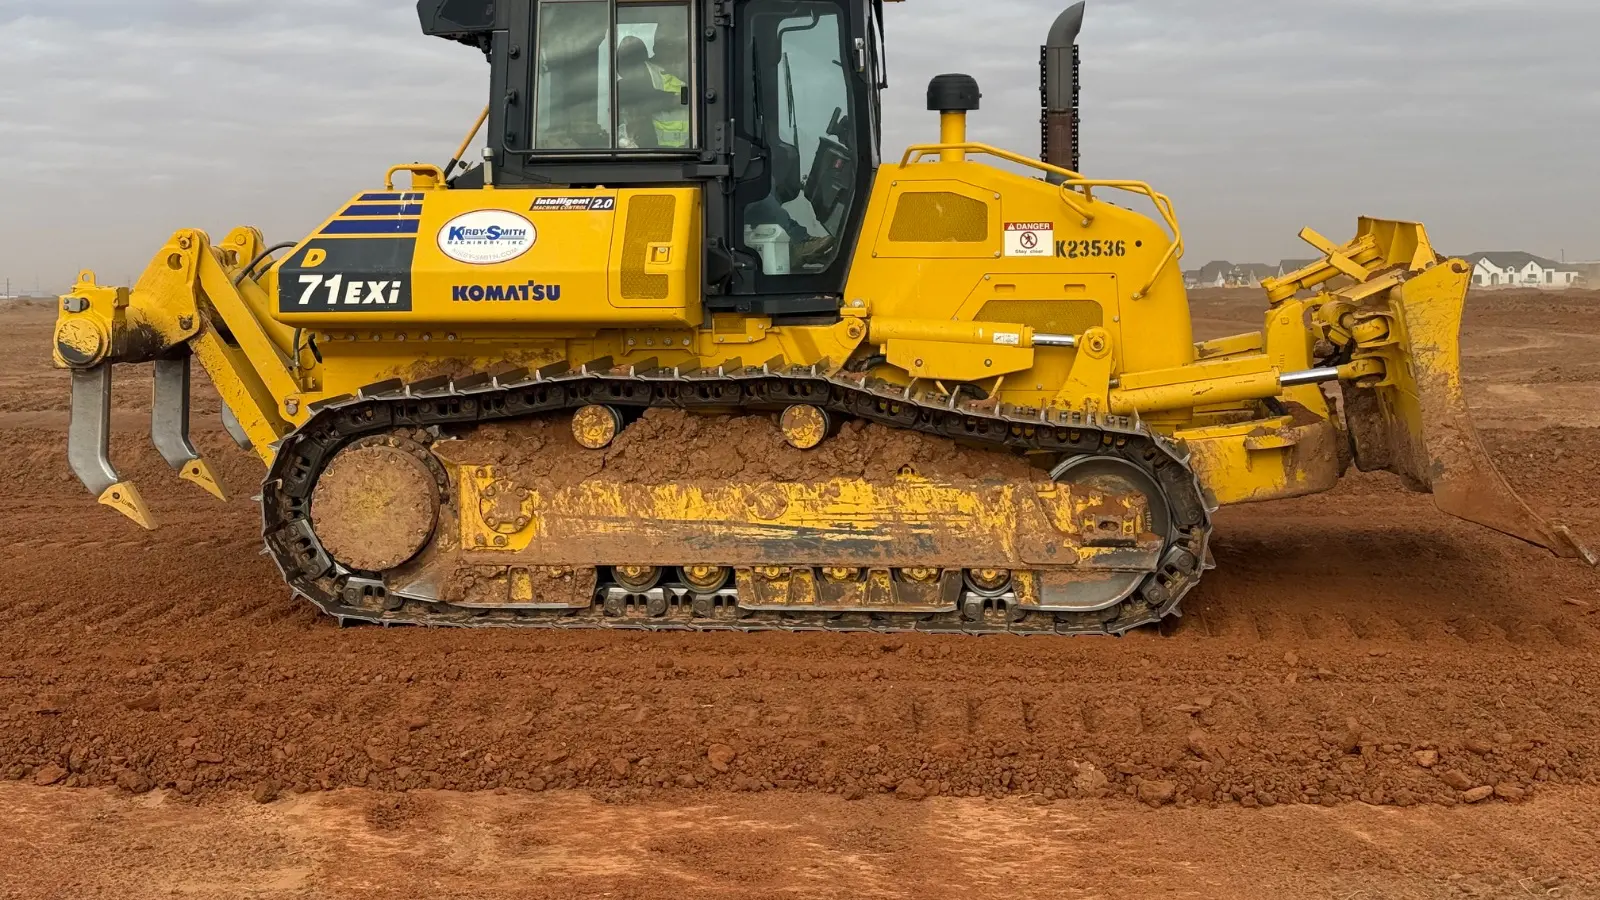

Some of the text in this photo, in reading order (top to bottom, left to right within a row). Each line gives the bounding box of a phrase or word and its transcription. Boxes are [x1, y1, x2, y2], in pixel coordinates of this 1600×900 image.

[591, 199, 613, 209] 2.0
[448, 225, 526, 241] KIRBY-SMITH
[300, 248, 327, 268] D
[1056, 240, 1125, 258] K23536
[452, 280, 560, 301] KOMATSU
